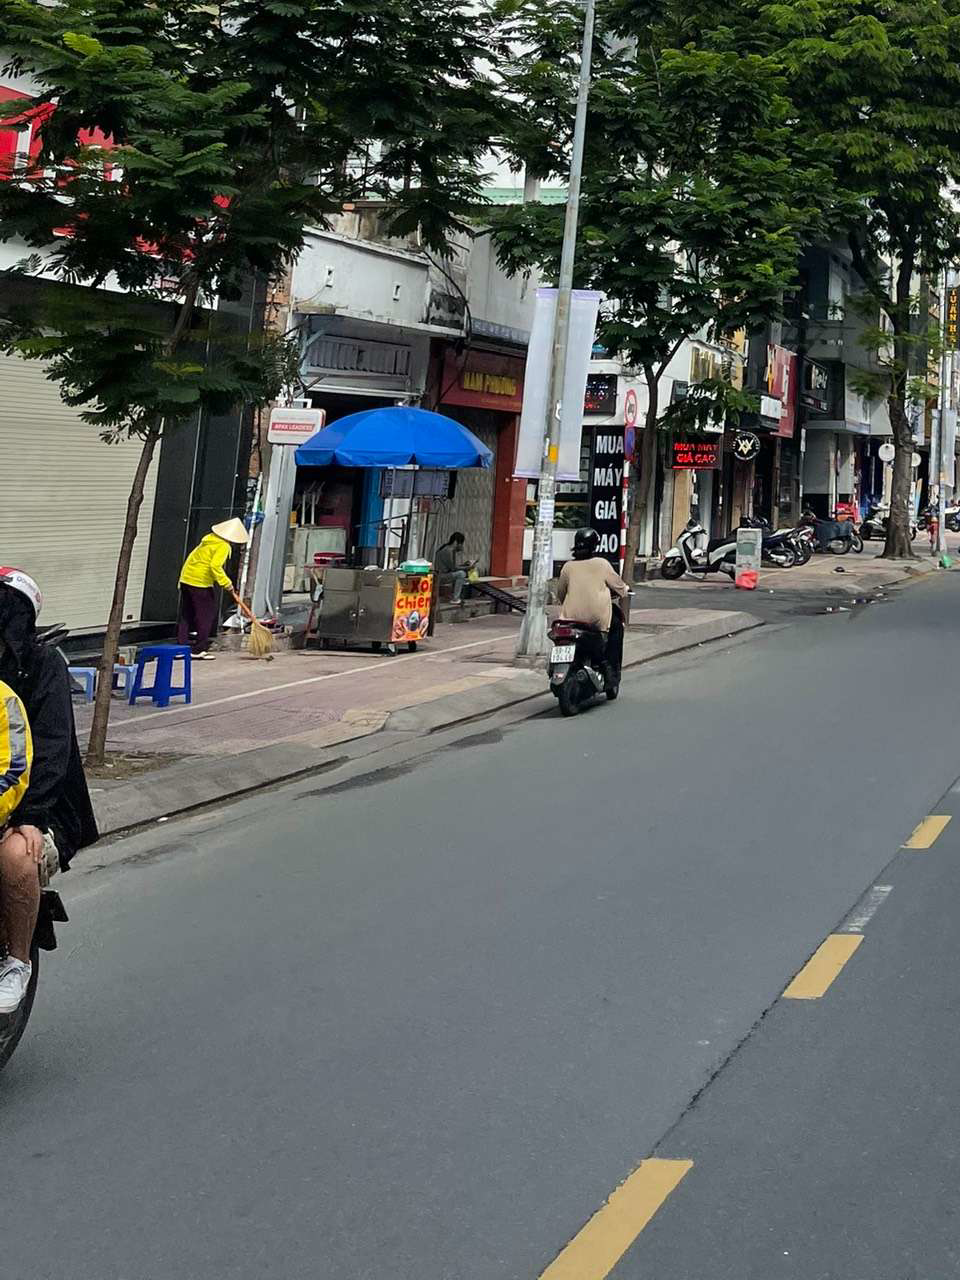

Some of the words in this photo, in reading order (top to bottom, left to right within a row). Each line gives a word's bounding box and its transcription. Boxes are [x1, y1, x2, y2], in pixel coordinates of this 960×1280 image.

[596, 435, 624, 455] MUA
[594, 463, 623, 487] MÁY
[595, 496, 618, 520] GIÁ
